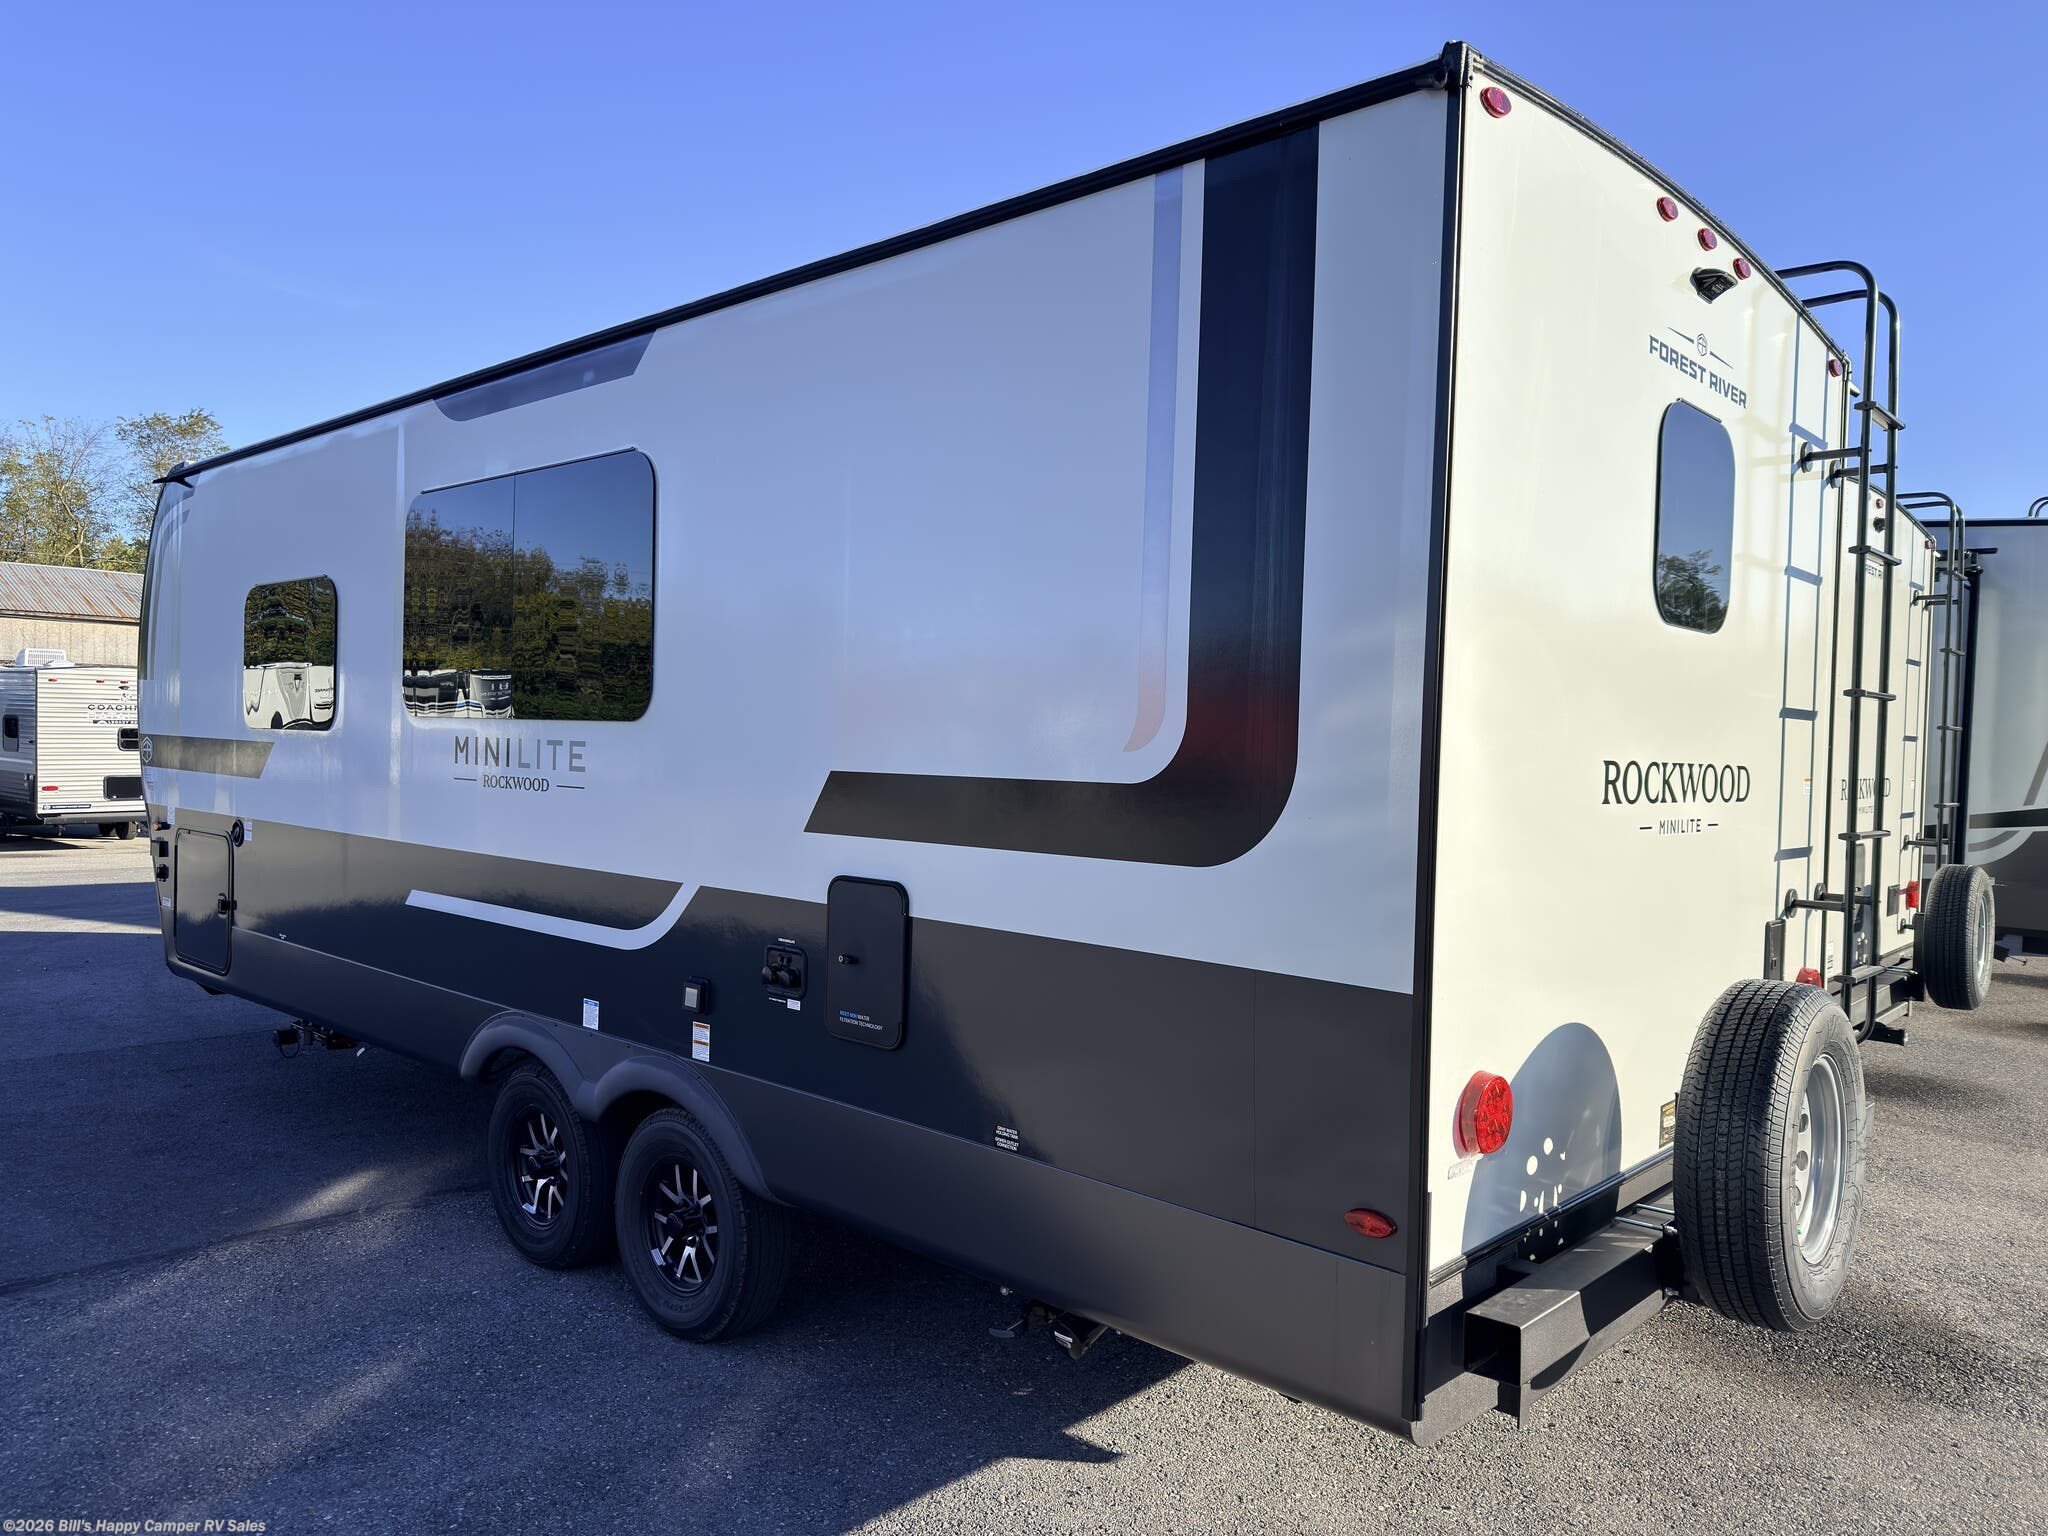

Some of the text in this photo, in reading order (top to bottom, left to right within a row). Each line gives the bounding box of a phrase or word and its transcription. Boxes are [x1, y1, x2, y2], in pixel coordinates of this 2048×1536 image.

[1649, 334, 1747, 409] FOREST RIVER
[454, 735, 587, 773] MINILITE
[483, 774, 550, 792] ROCKWOOD
[1601, 760, 1751, 805] ROCKWOOD
[1659, 818, 1702, 835] MINILITE
